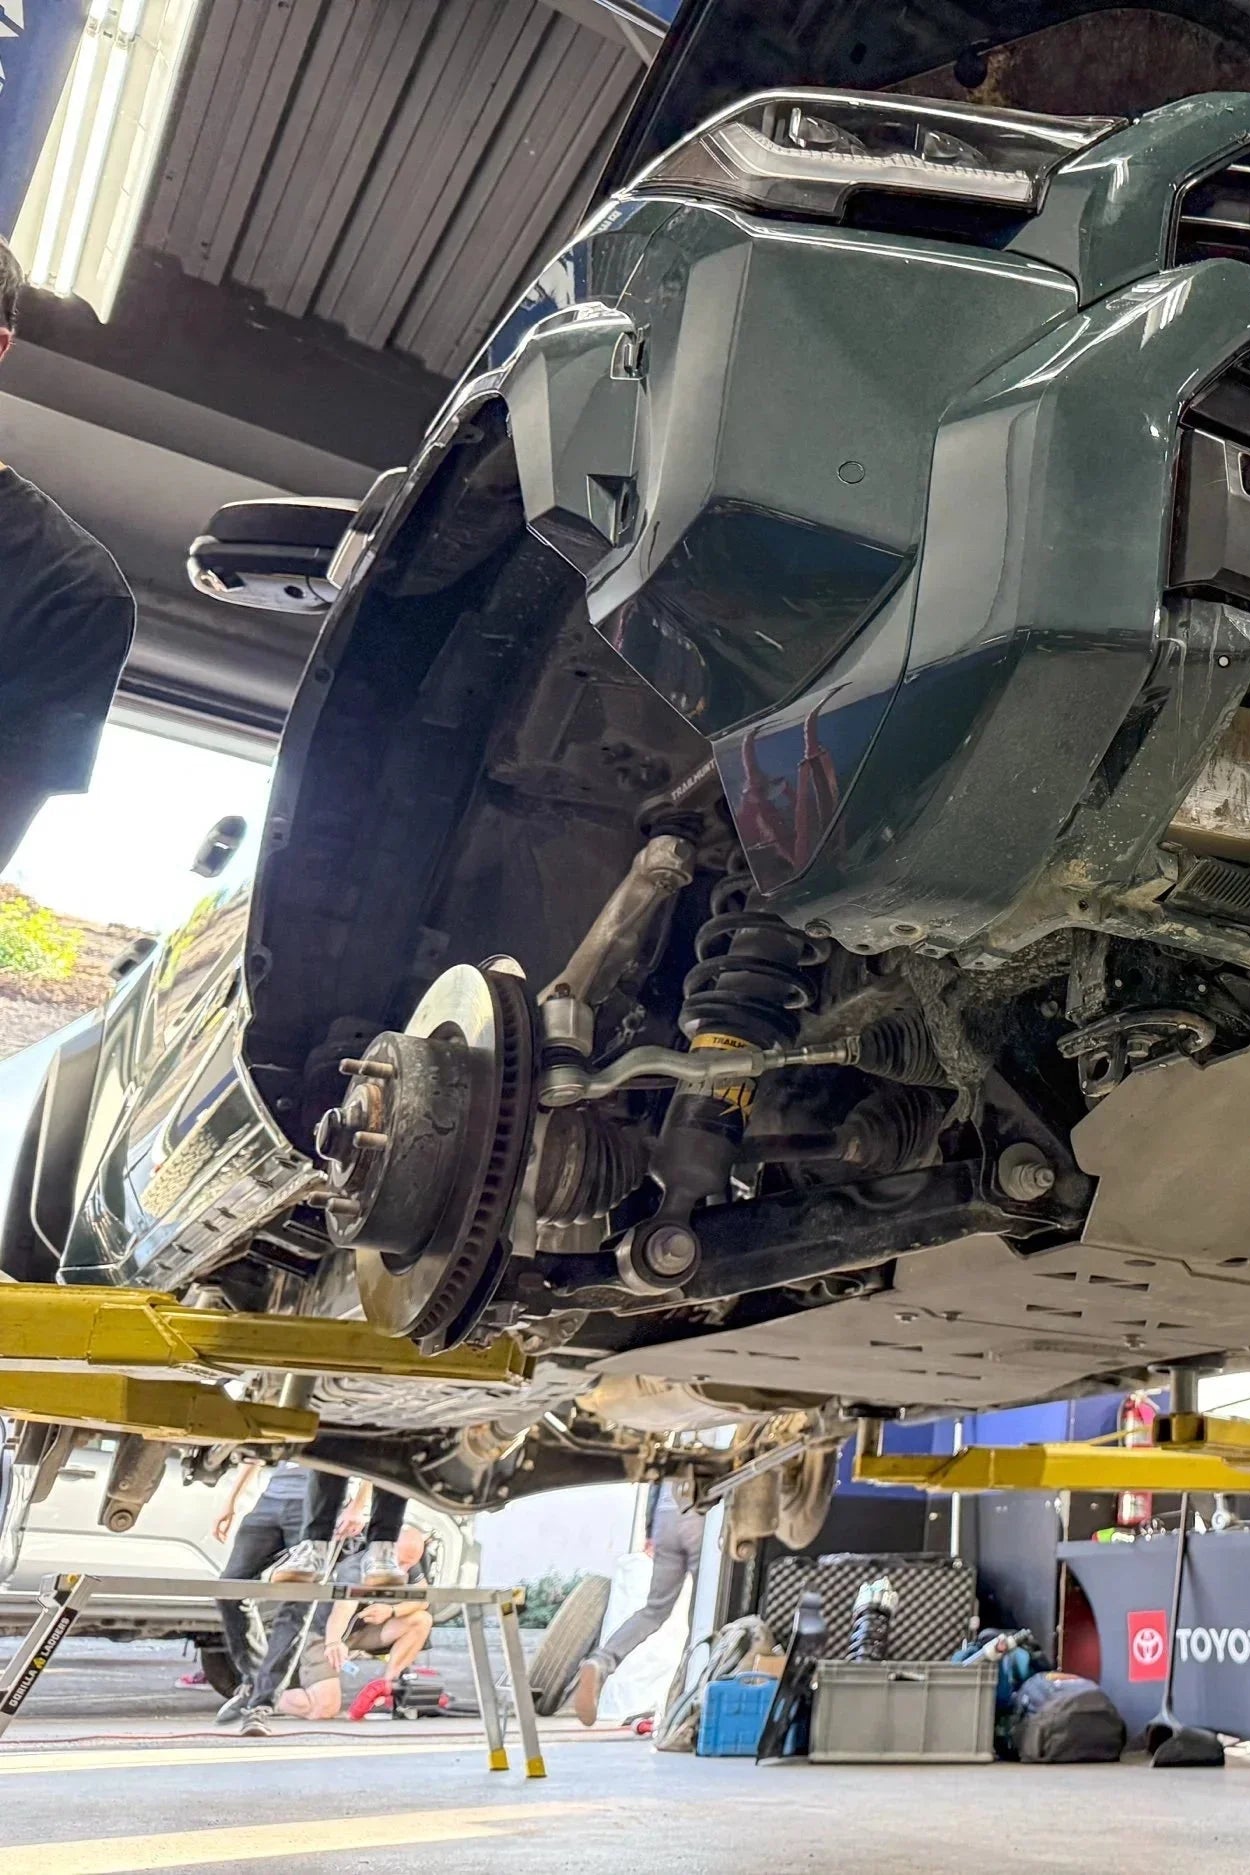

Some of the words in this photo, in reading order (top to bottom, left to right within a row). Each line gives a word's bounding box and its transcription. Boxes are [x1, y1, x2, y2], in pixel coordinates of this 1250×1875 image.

[671, 758, 715, 801] TRAILHUNT
[9, 1669, 38, 1707] GORILLA
[41, 1617, 71, 1657] LADDERS
